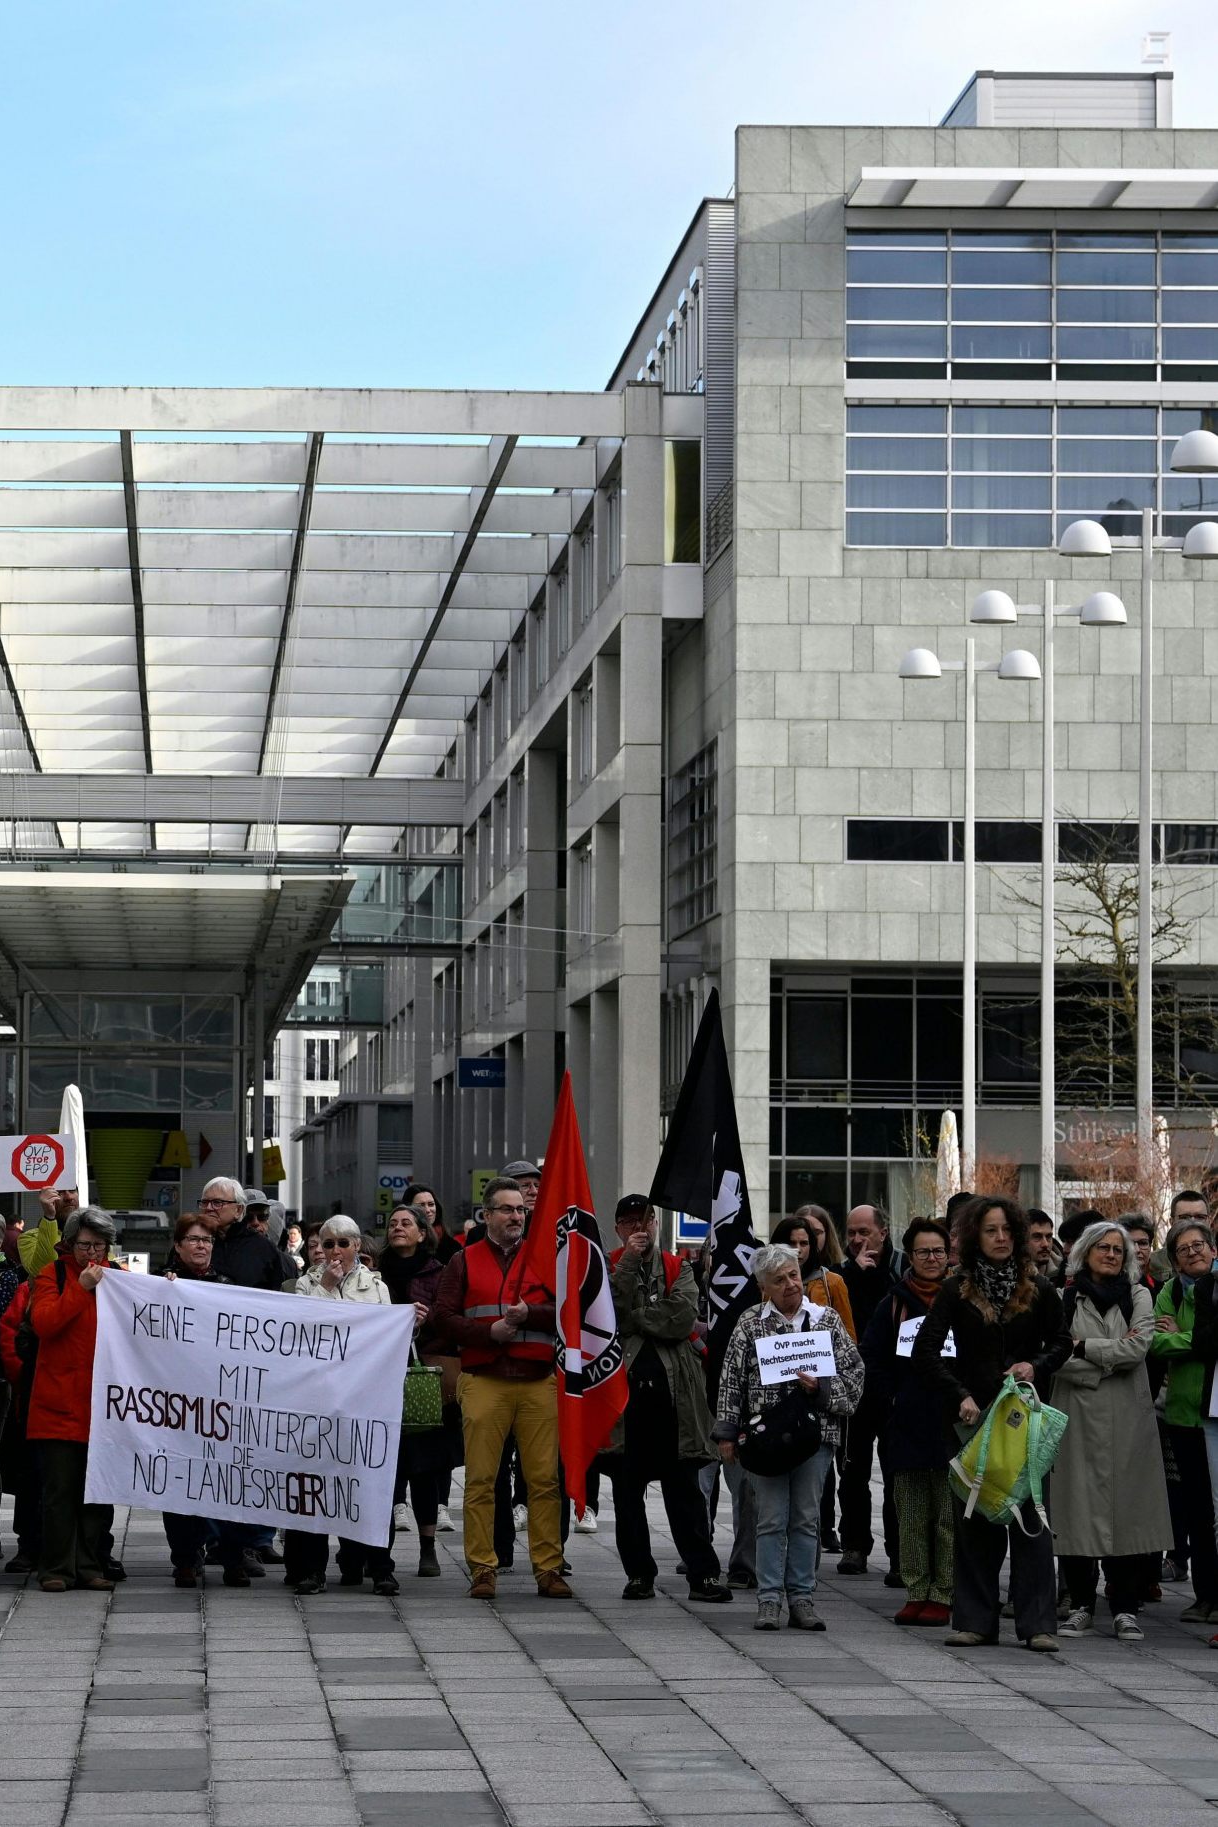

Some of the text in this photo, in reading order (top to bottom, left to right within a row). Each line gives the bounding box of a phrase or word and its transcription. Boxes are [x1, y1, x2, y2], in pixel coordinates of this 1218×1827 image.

[380, 1194, 388, 1206] 5
[132, 1302, 351, 1362] KEINE PERSONEN
[774, 1338, 815, 1350] ÖVP macht
[760, 1350, 831, 1366] Rechtsextremismus
[219, 1363, 269, 1403] MIT
[106, 1384, 389, 1469] RASSISMUSHINTERGRUND
[203, 1440, 254, 1467] IN DIE
